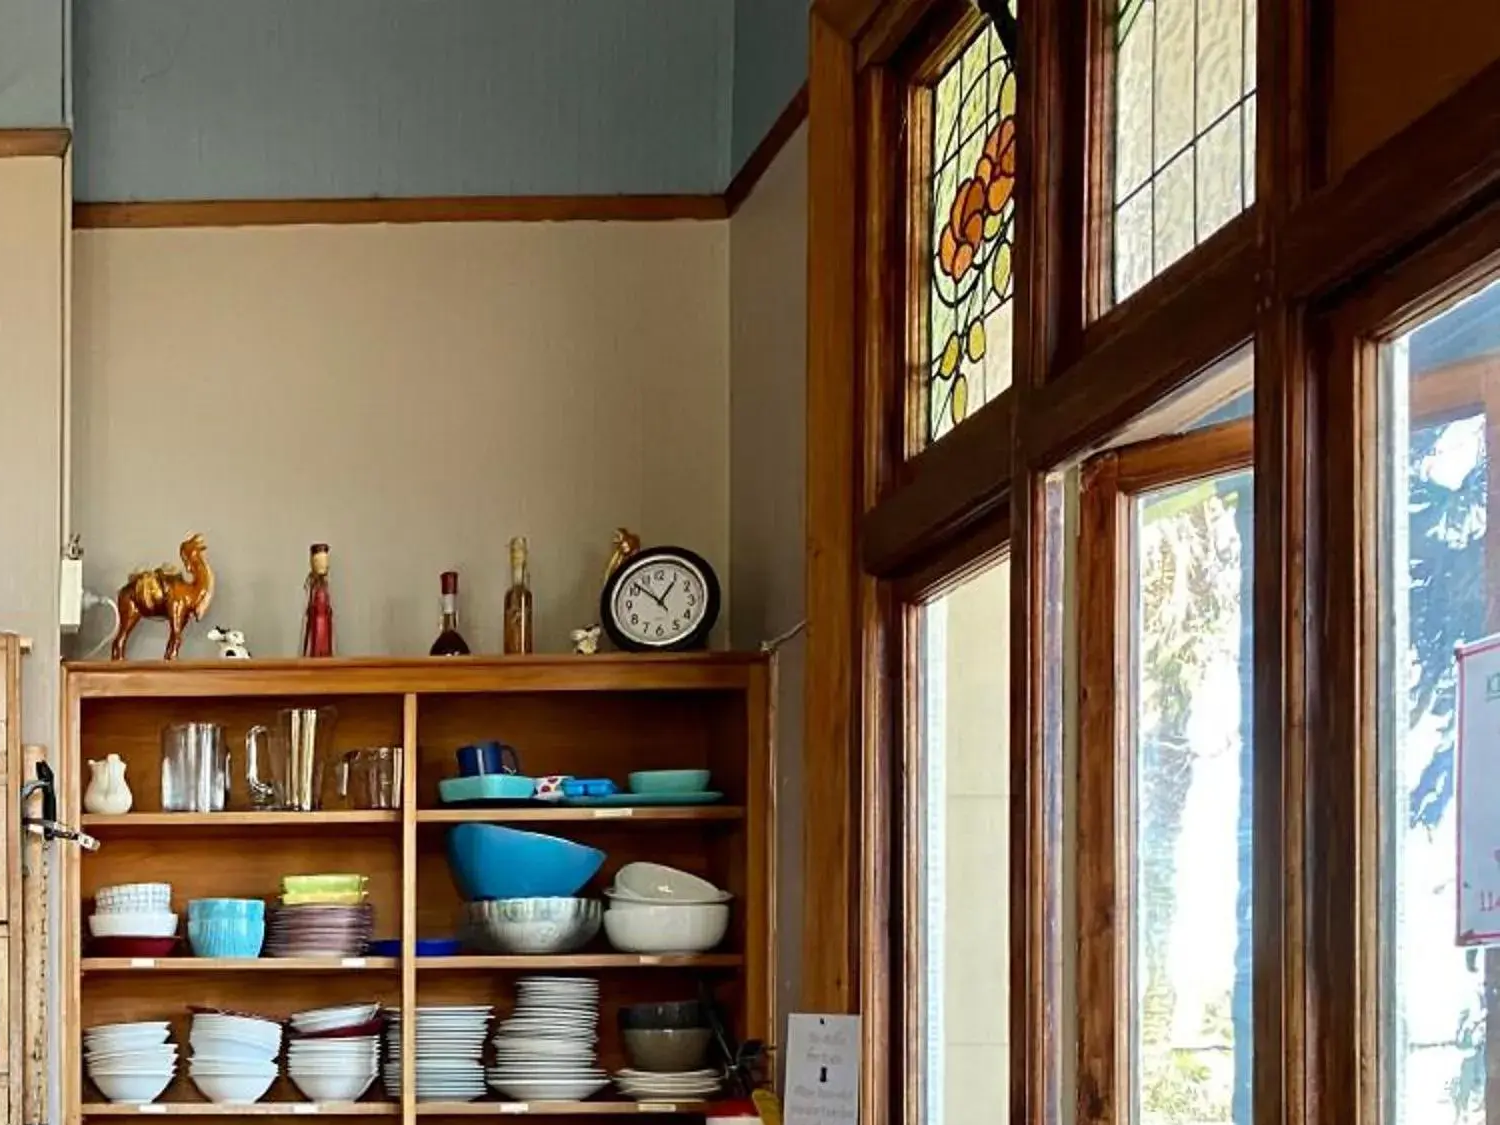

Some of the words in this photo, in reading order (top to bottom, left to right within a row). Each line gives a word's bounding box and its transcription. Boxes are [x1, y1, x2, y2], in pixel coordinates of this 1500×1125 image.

[654, 569, 665, 581] 12
[683, 580, 691, 592] 2
[625, 600, 633, 611] 9
[687, 593, 695, 606] 3
[630, 613, 639, 625] 8
[683, 608, 691, 620] 4
[643, 621, 651, 634] 7
[655, 625, 665, 637] 6
[672, 619, 681, 631] 5
